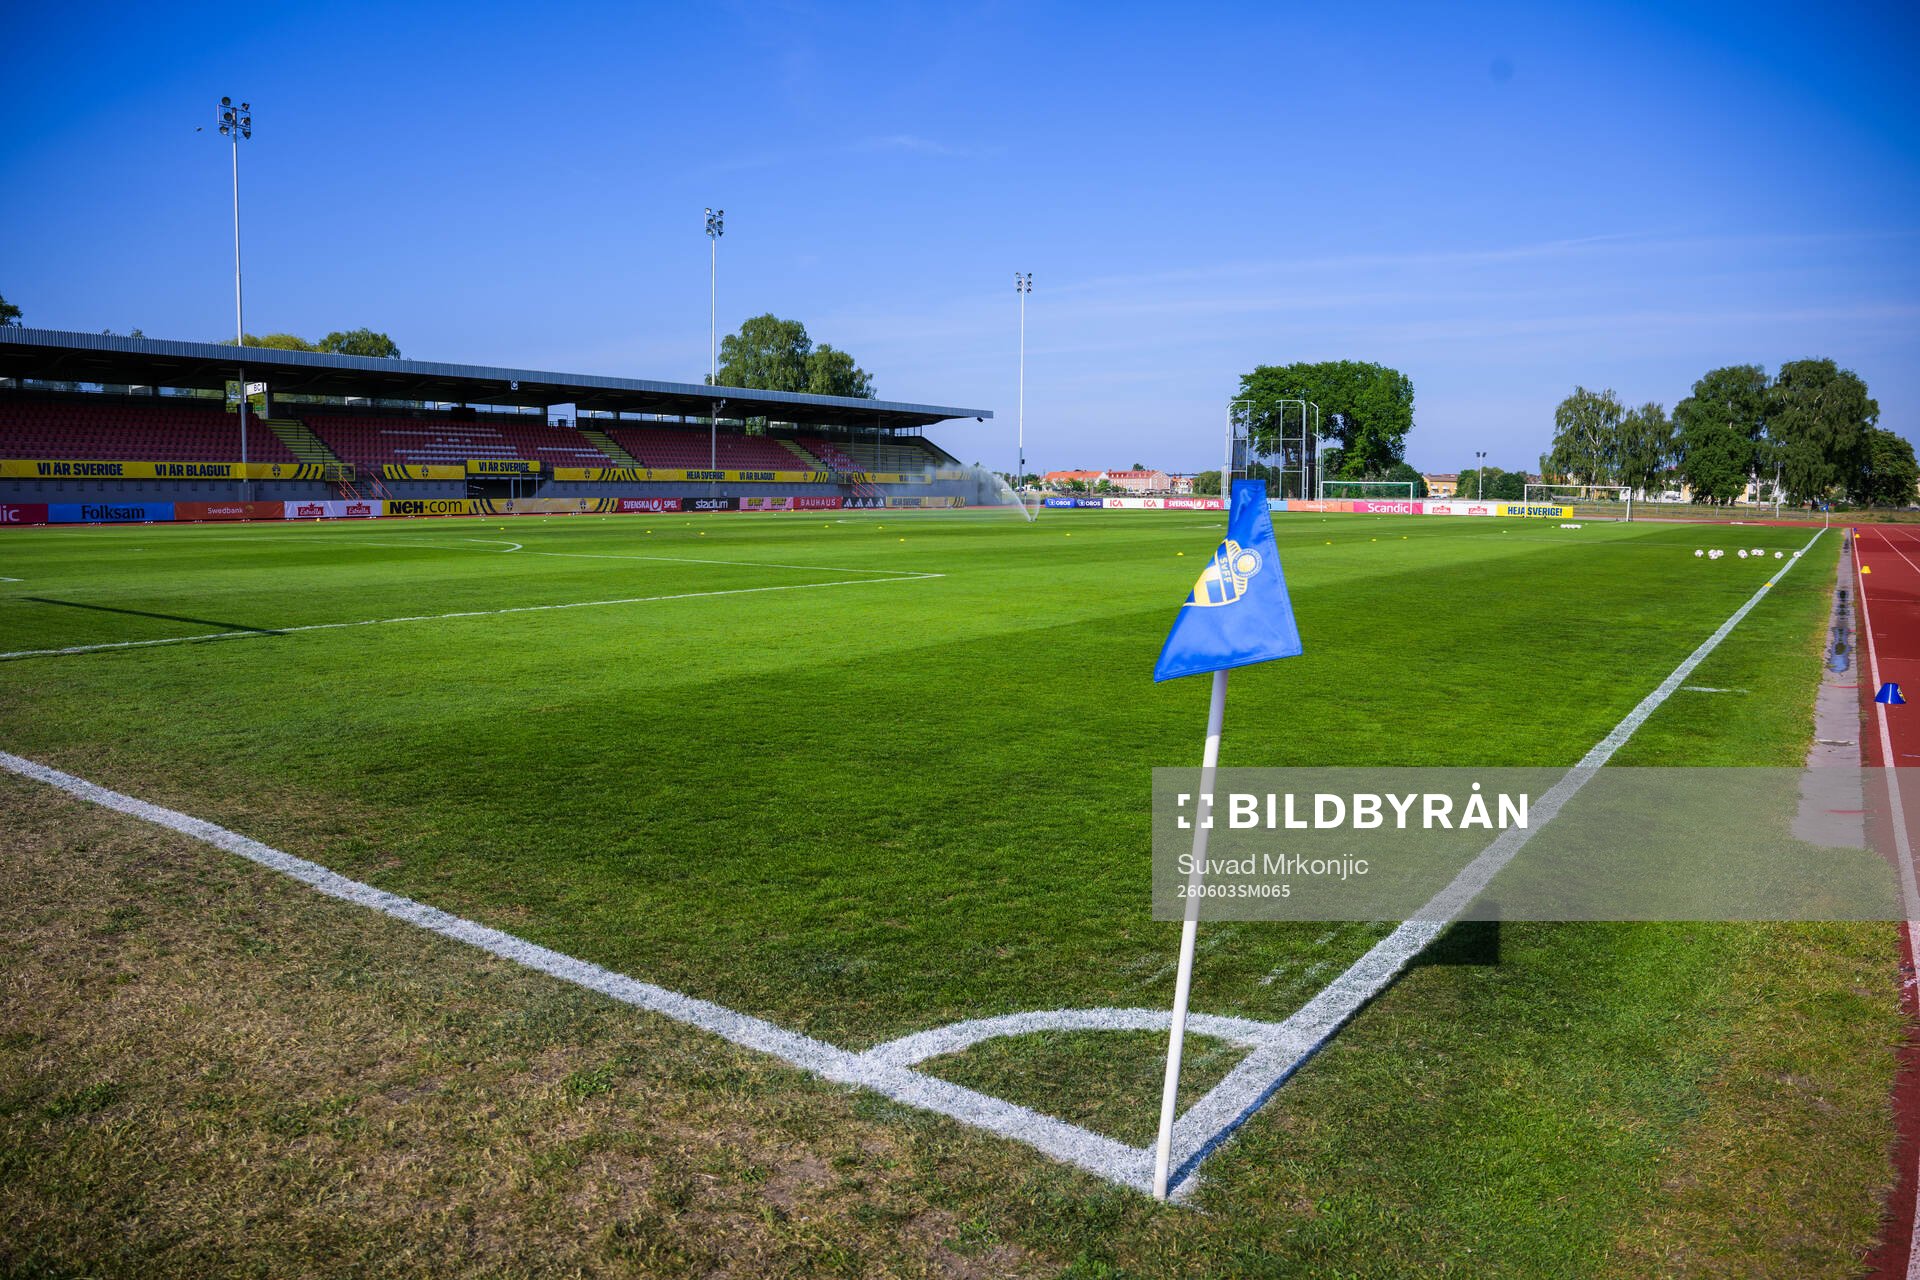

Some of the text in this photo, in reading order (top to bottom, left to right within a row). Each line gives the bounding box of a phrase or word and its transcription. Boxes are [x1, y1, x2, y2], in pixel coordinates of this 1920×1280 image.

[37, 462, 123, 476] VI ÄR SVERIGE
[154, 464, 166, 476] VI
[169, 464, 184, 476] ÄR
[479, 462, 487, 472] VI
[500, 462, 530, 472] SVERIGE
[624, 500, 678, 509] SVENSKA SPEL
[696, 500, 728, 508] stadium
[1110, 499, 1123, 507] ICA
[1368, 503, 1408, 513] Scandic
[81, 505, 144, 520] Folksam
[1508, 506, 1562, 516] HEJA SVERIGE!
